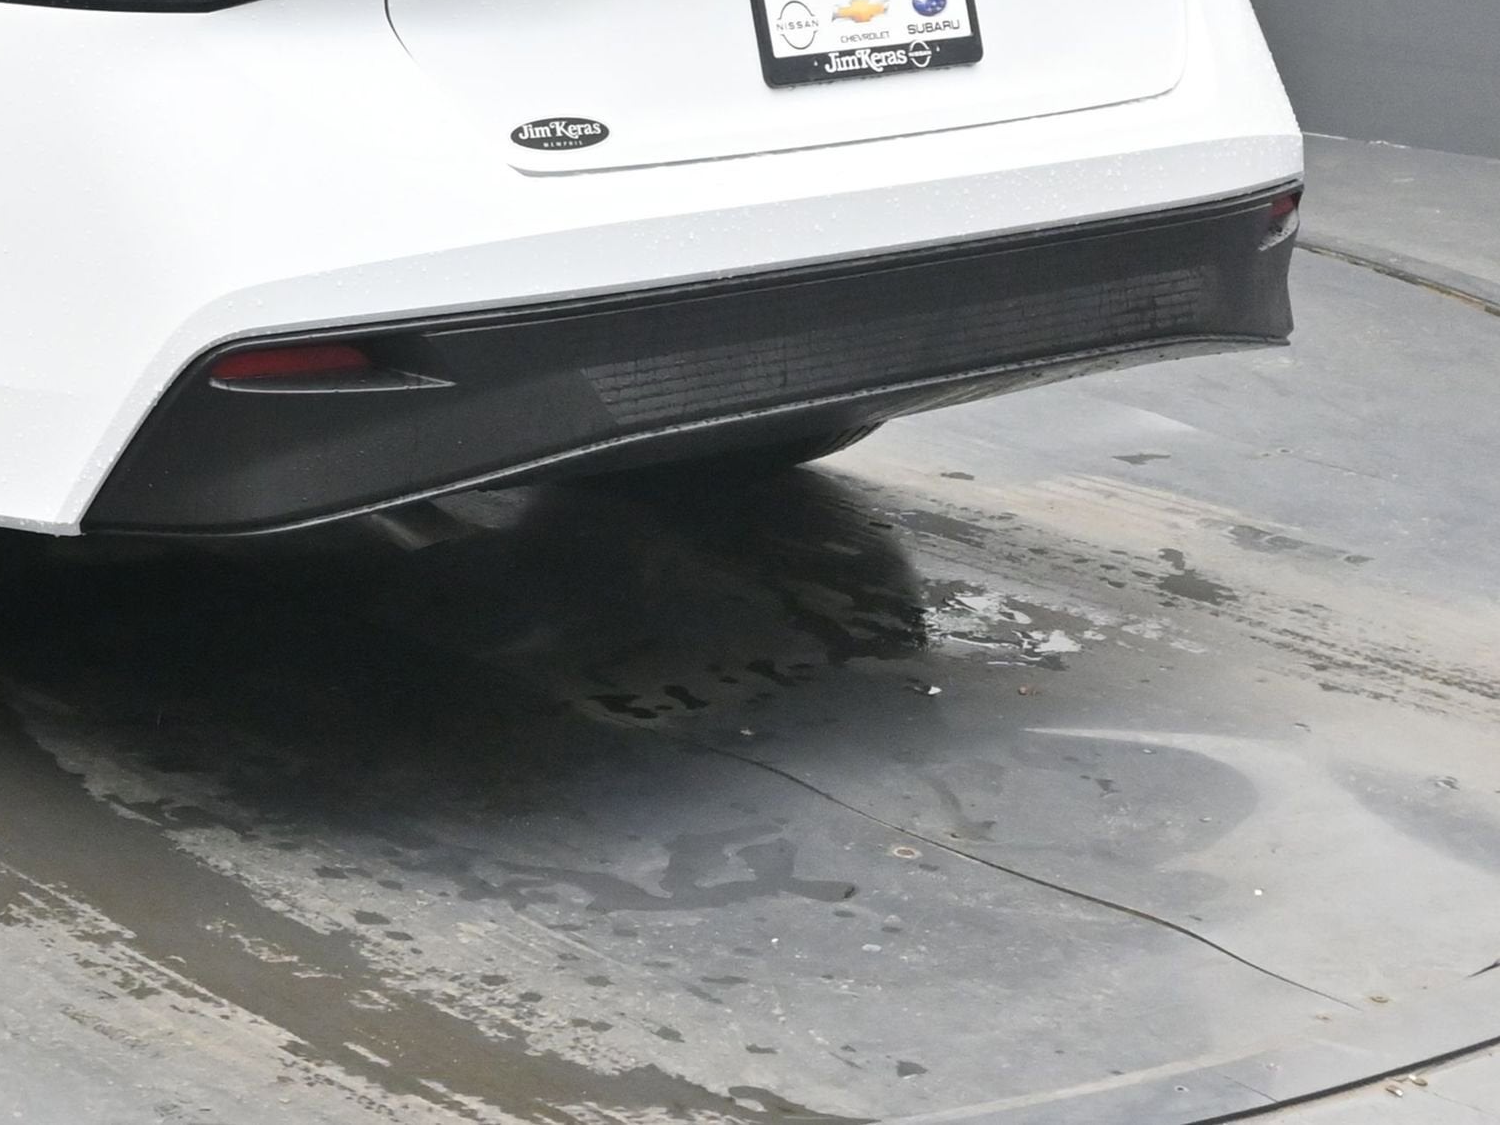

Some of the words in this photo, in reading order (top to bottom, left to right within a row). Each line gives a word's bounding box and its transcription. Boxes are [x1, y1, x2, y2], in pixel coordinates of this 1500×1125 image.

[776, 19, 819, 31] NISSAN
[907, 19, 961, 35] SUBARU
[840, 31, 890, 43] CHEVROLET
